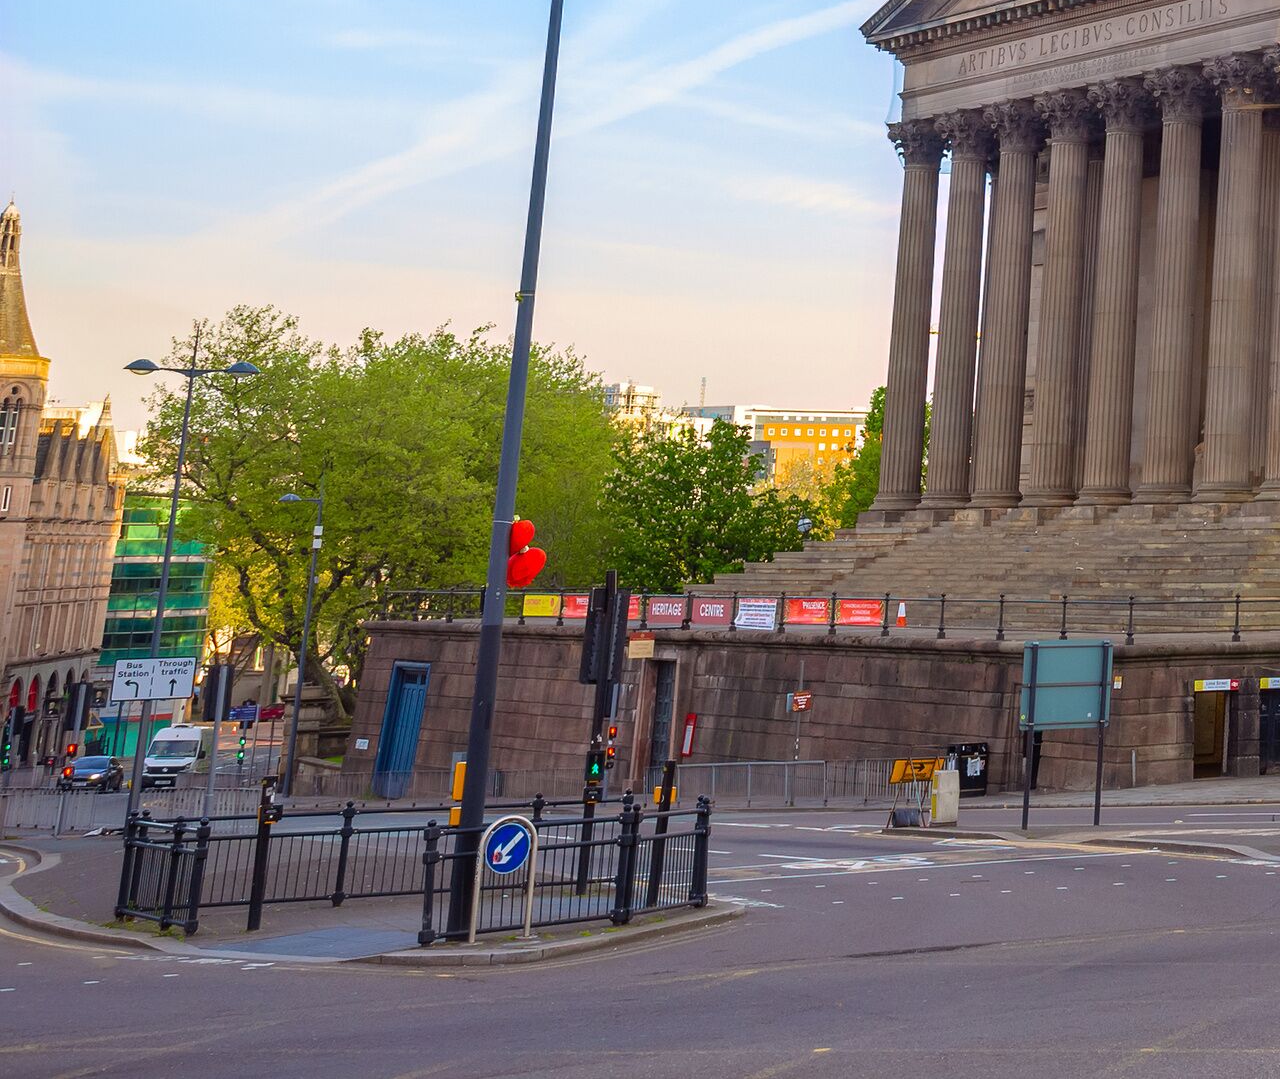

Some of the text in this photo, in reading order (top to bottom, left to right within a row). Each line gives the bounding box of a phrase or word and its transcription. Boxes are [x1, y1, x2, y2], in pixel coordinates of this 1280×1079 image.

[958, 42, 1027, 75] ARTIBVS
[651, 603, 682, 616] HERITAGE
[699, 604, 724, 617] CENTRE
[158, 660, 194, 668] Through
[117, 670, 150, 678] Station
[160, 668, 188, 676] traffic
